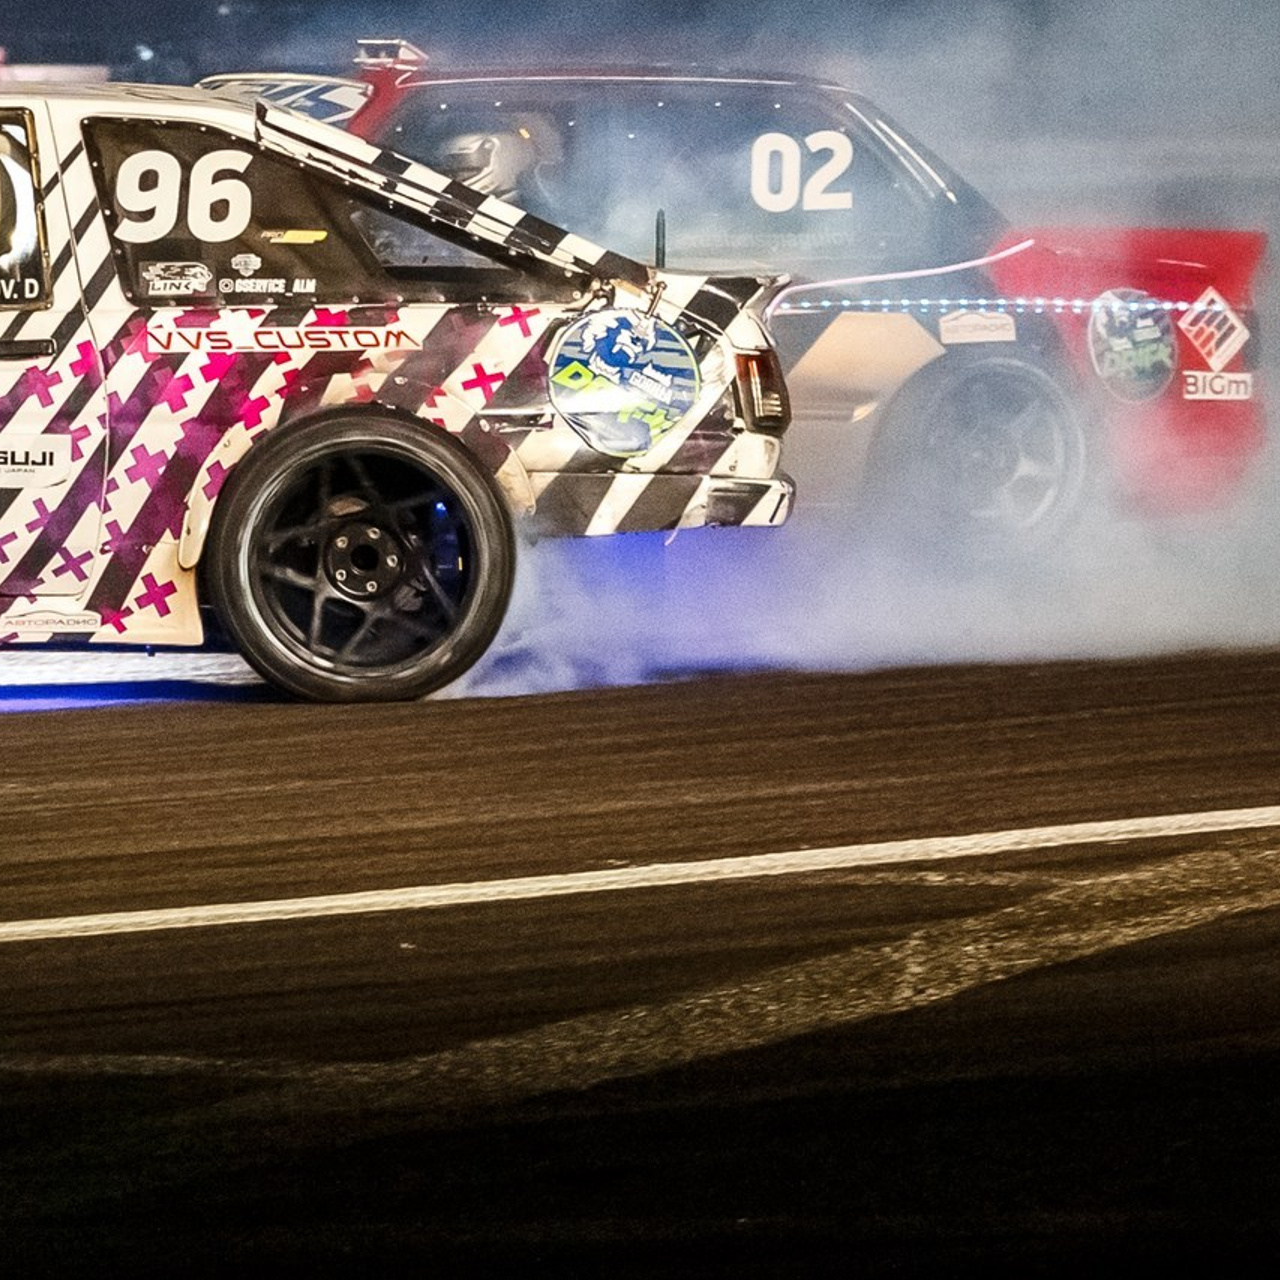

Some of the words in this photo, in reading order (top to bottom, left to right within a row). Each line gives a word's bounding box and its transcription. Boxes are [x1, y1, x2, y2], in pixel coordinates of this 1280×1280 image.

[114, 149, 254, 244] 96
[751, 130, 854, 213] 02
[24, 278, 39, 299] D
